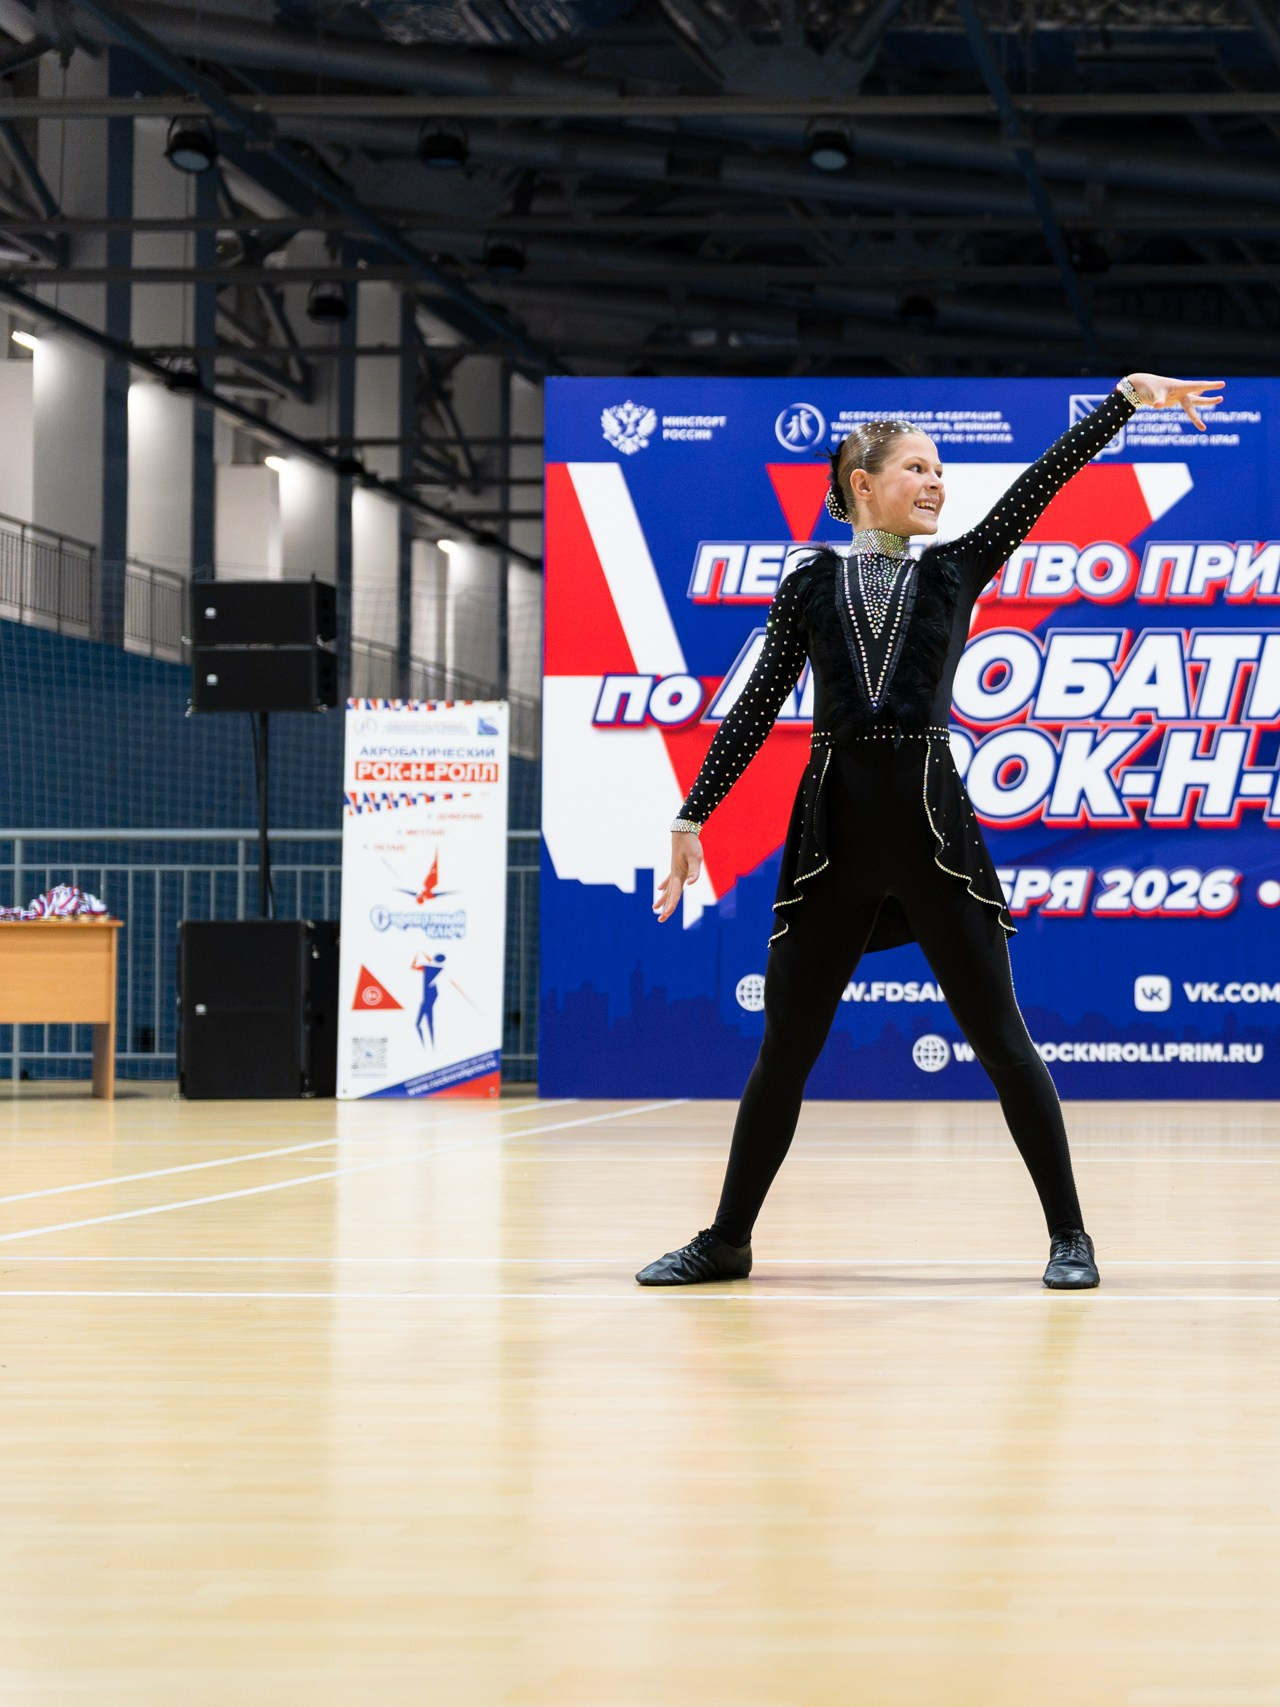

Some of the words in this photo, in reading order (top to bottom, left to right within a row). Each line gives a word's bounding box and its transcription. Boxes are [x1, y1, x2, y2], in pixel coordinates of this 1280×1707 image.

[662, 415, 727, 428] МИНСПОРТ
[662, 428, 713, 441] РОССИИ
[360, 745, 496, 758] АКРОБАТИЧЕСКИЙ
[1095, 867, 1241, 917] 2026
